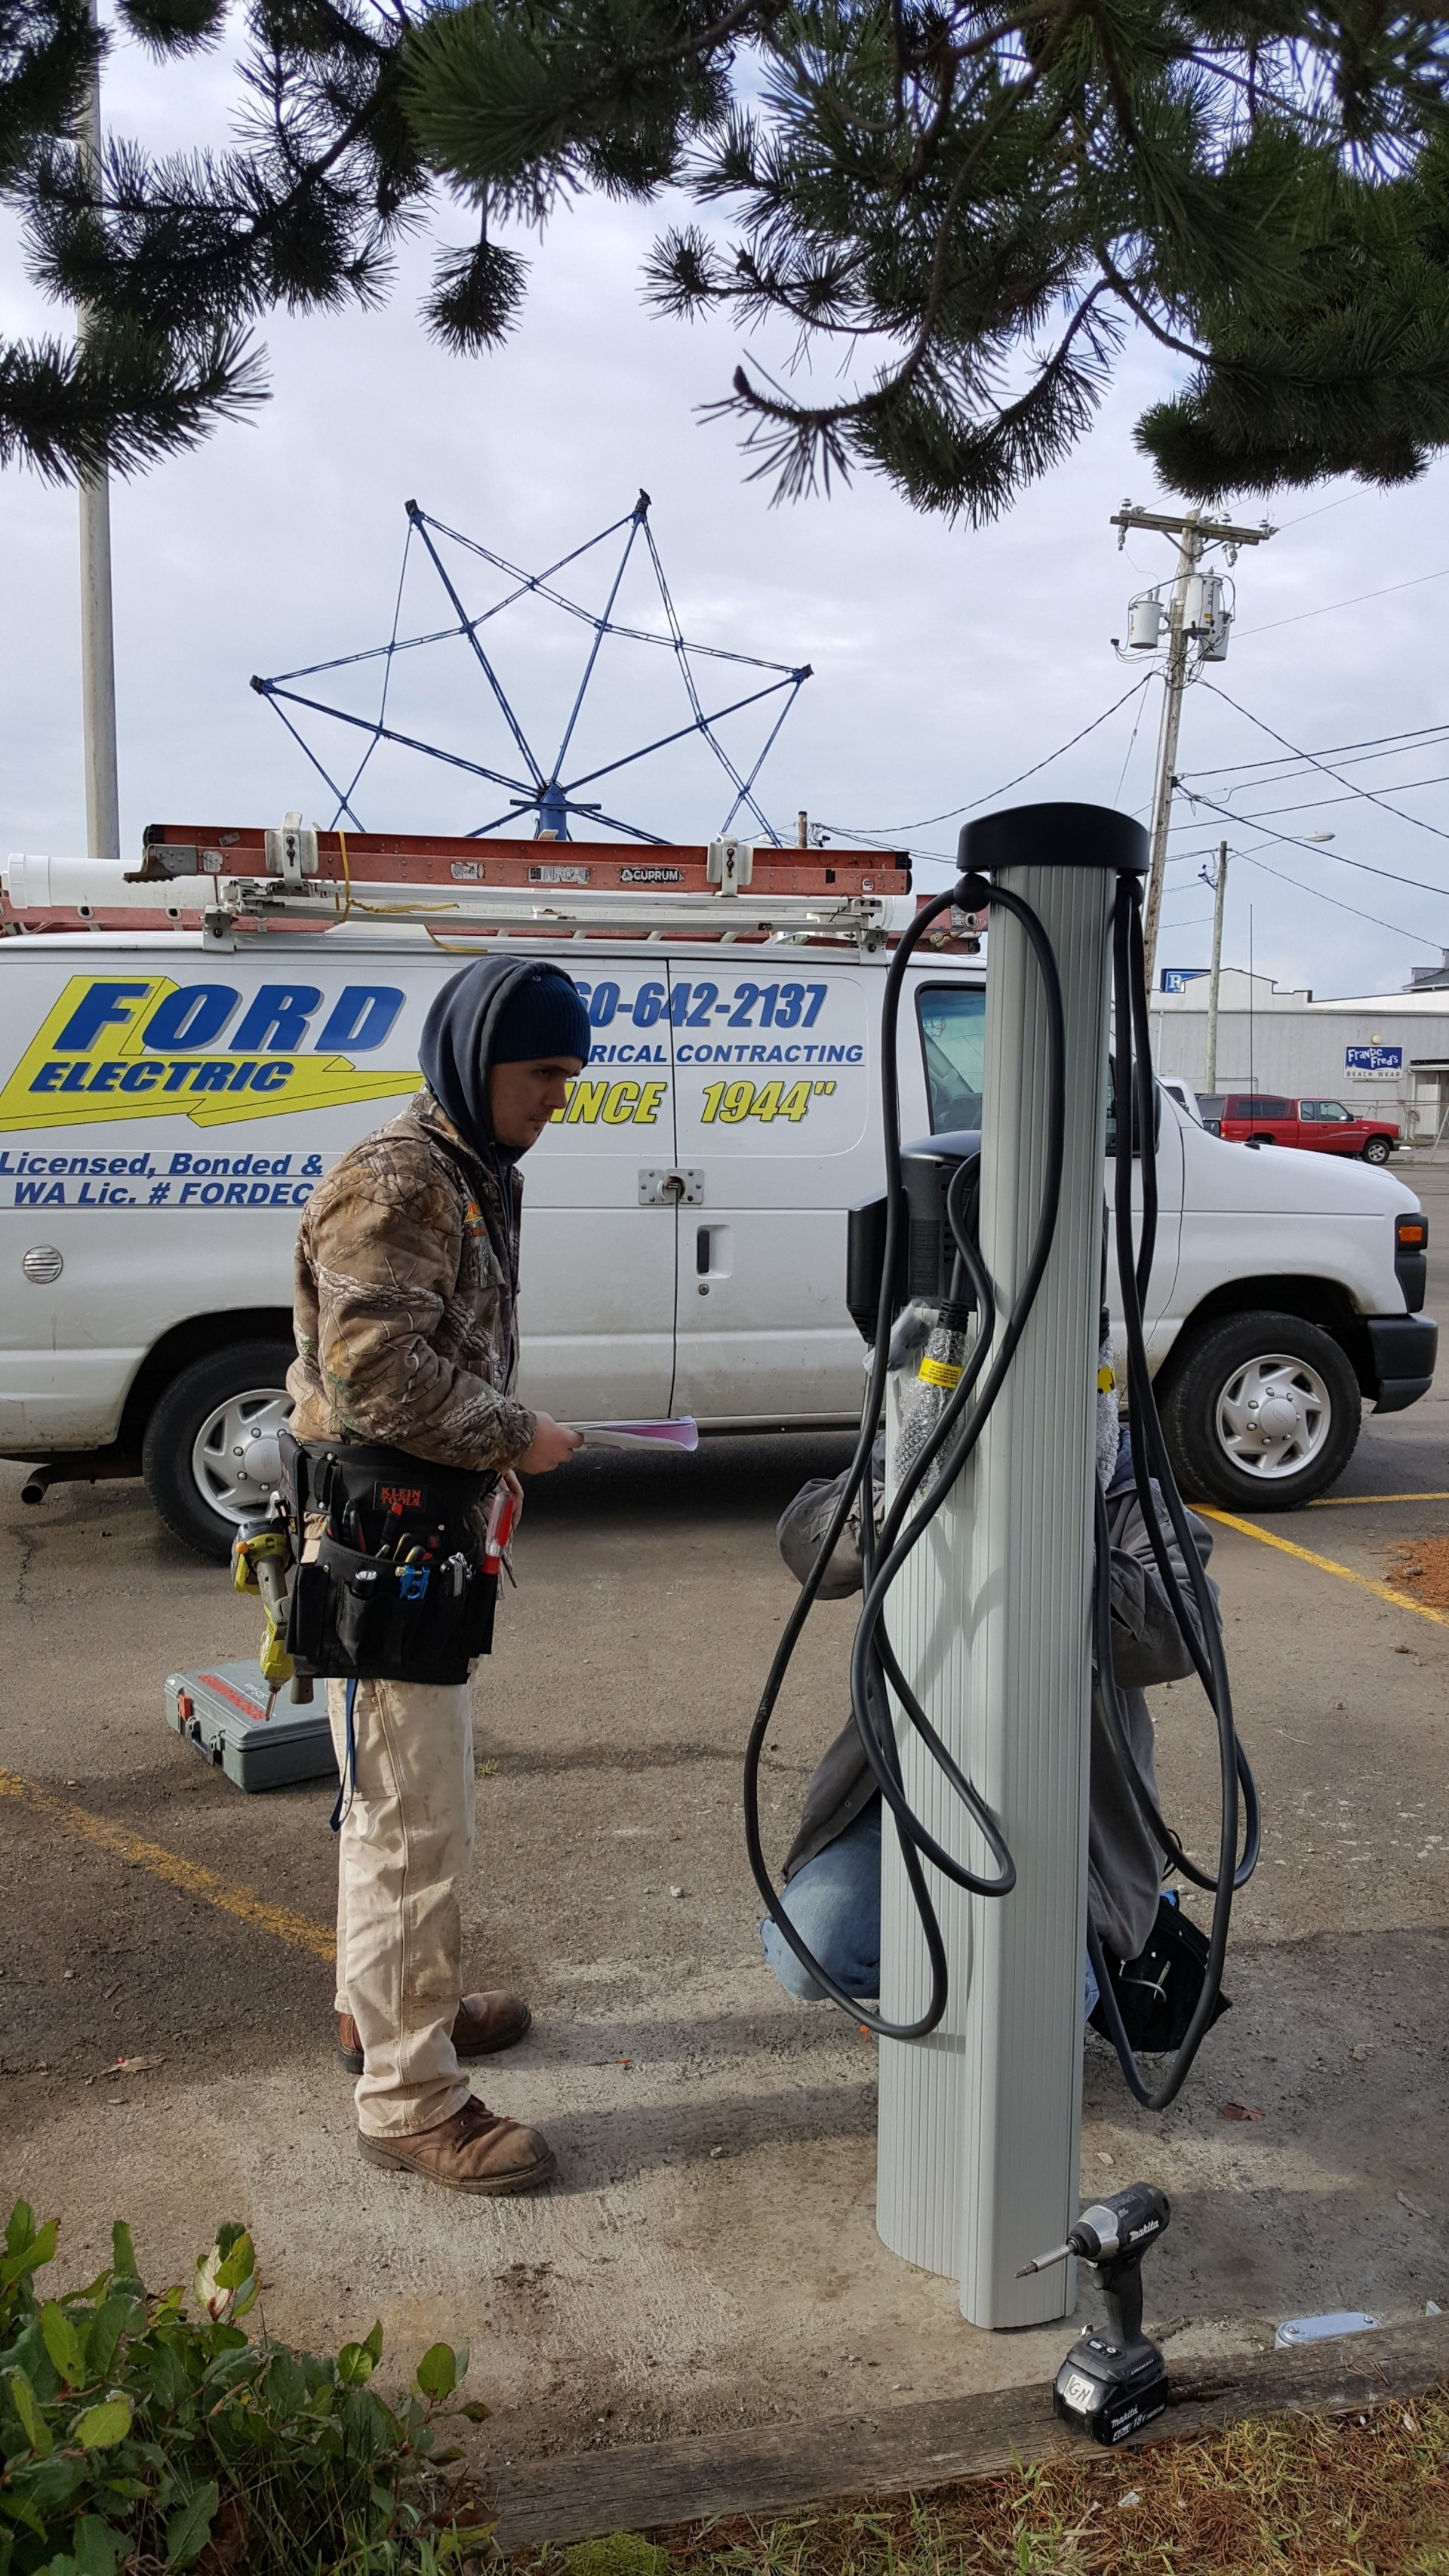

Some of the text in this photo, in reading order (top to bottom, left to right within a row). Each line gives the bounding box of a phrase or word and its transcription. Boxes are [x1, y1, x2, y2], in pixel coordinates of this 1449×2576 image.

[633, 870, 678, 881] CUPRUM
[53, 983, 406, 1052] FORD
[676, 1045, 863, 1063] CONTRACTING
[28, 1061, 295, 1093] ELECTRIC
[701, 1080, 837, 1123] 1944"
[0, 1152, 324, 1179] Licensed, Bonded &
[14, 1182, 315, 1205] WA Lic. # FORDEC
[380, 1487, 421, 1498] KLEIN
[380, 1496, 420, 1507] TOOLS
